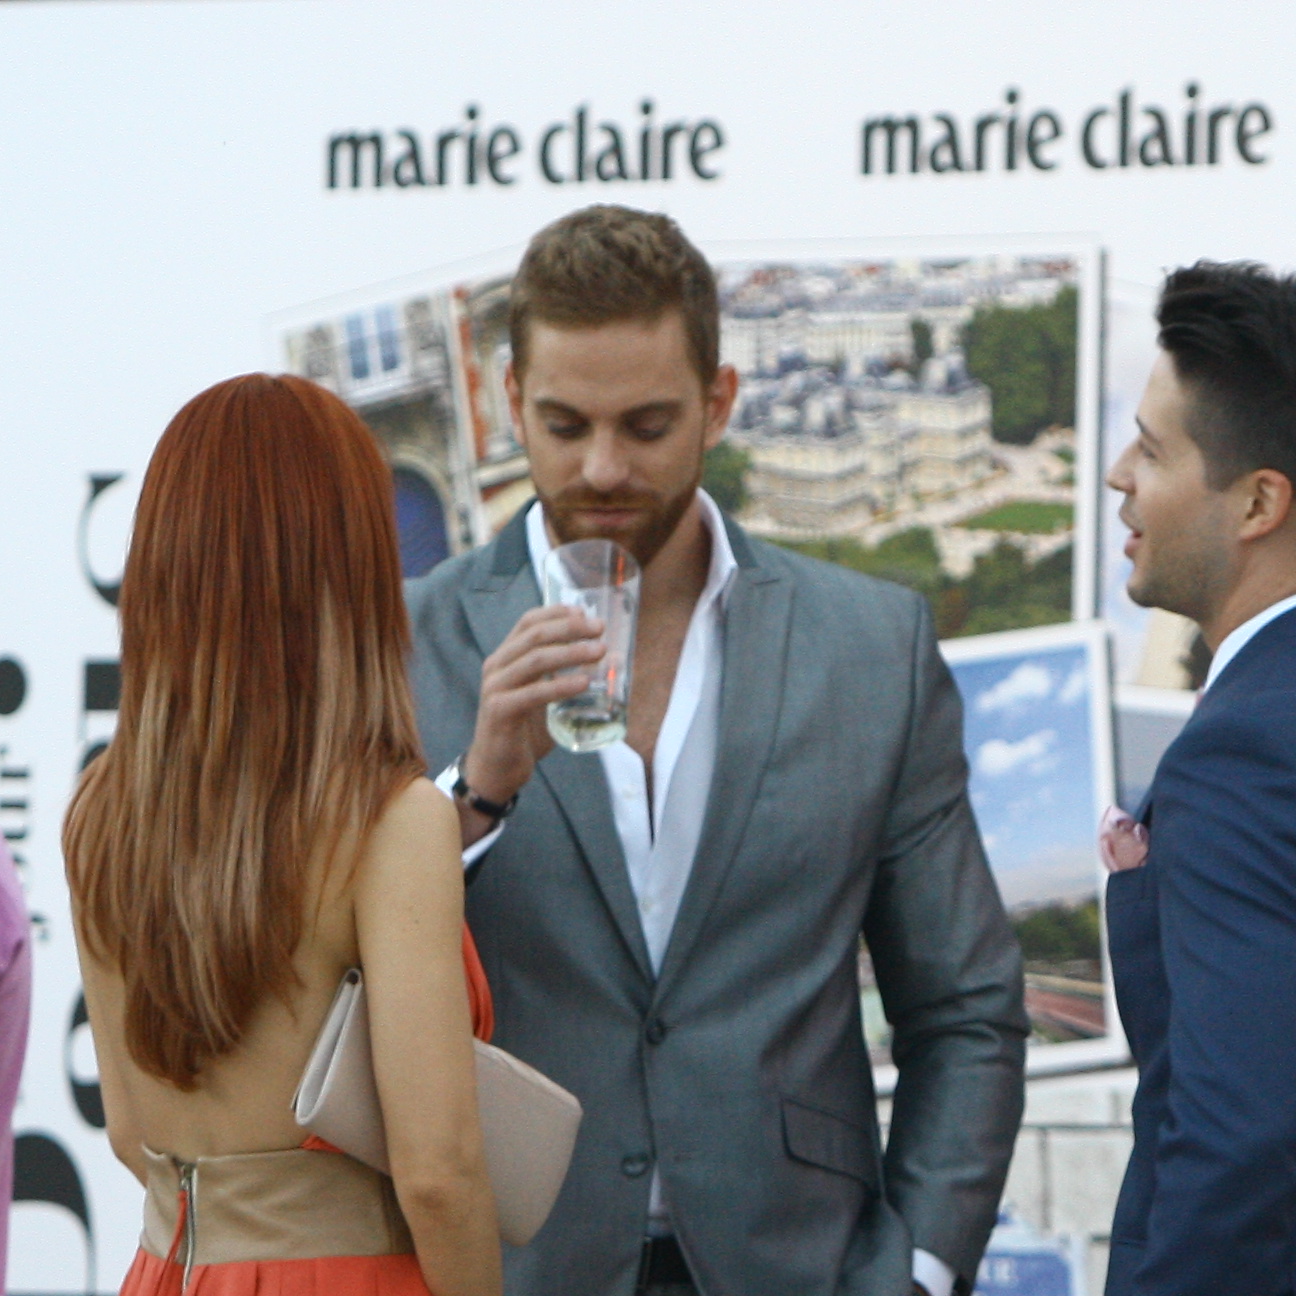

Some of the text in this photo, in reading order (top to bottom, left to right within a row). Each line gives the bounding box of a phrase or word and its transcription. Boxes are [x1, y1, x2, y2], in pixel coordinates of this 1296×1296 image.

[325, 97, 726, 191] marie claire
[859, 81, 1275, 178] marie claire
